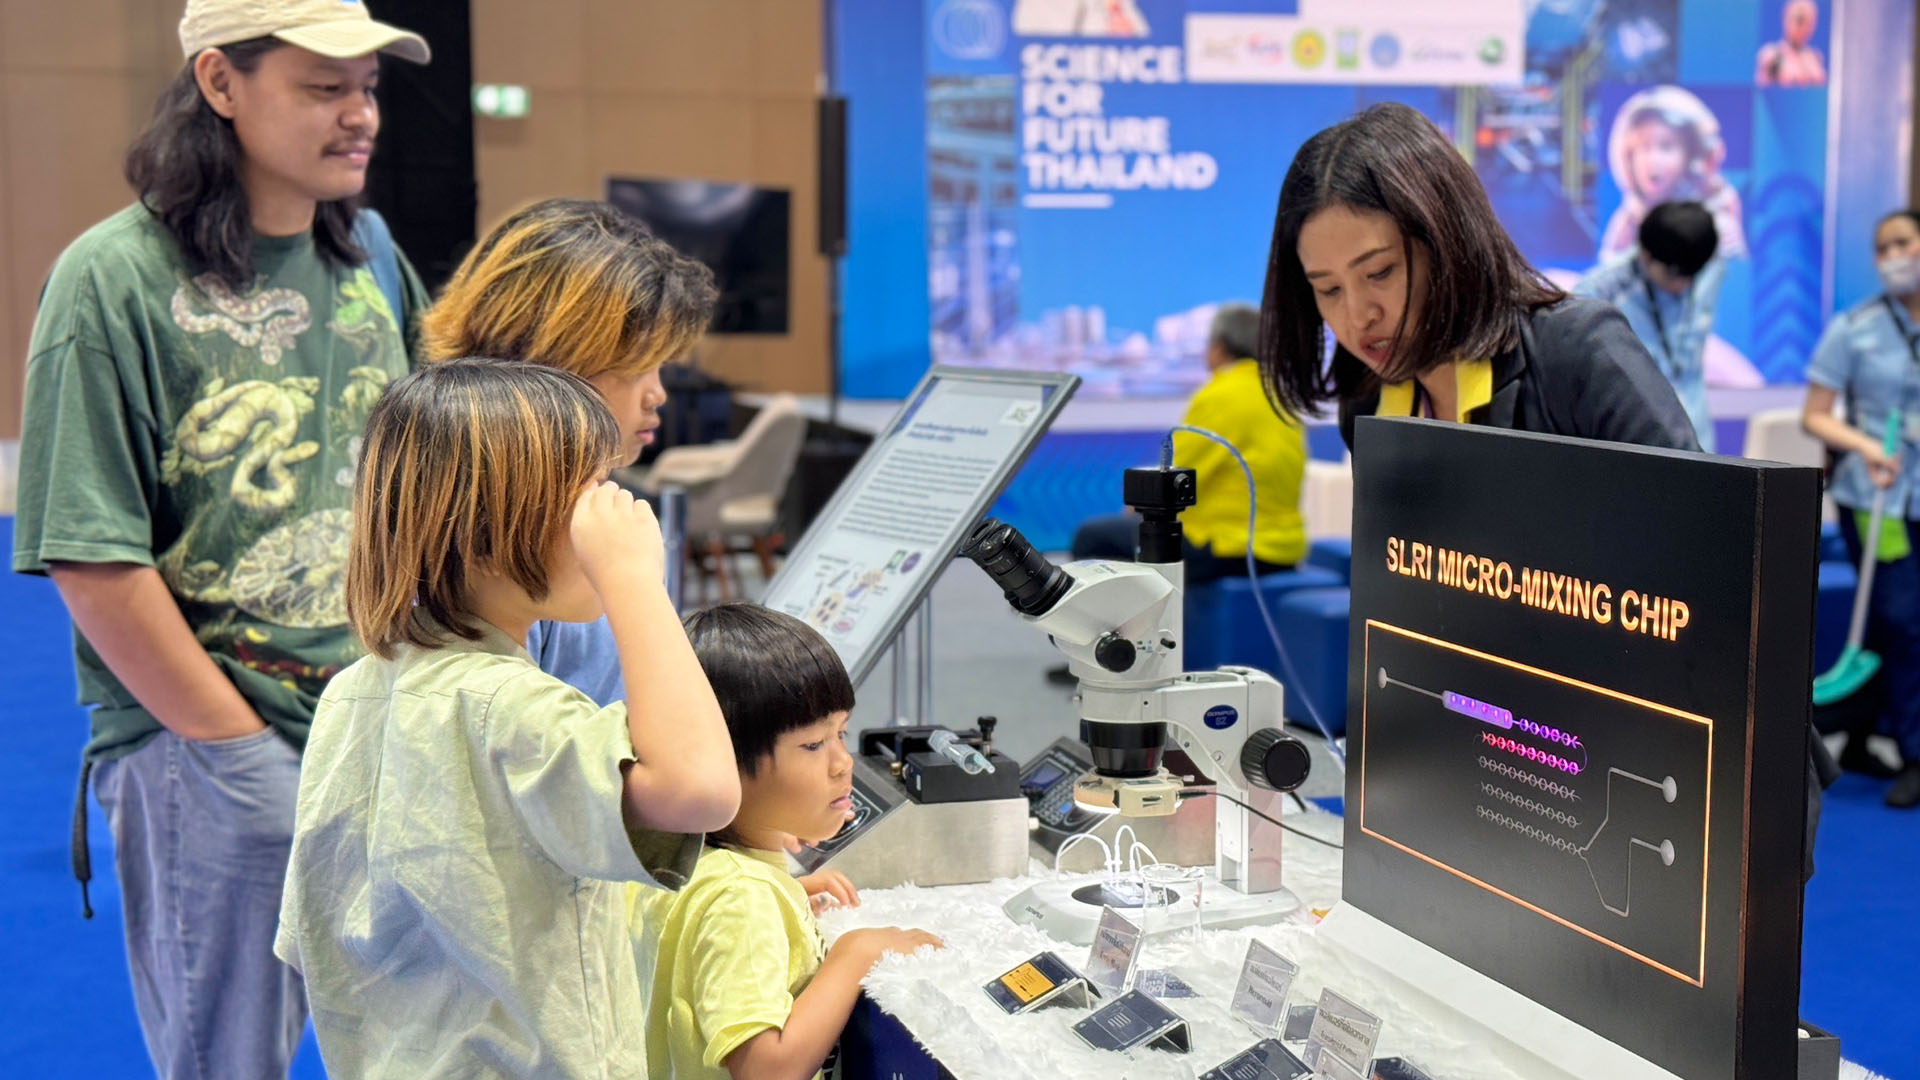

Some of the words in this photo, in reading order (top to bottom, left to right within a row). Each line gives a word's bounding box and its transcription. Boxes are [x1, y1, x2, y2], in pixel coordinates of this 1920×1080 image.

[1021, 44, 1182, 83] SCIENCE
[1023, 82, 1104, 117] FOR
[1023, 117, 1169, 153] FUTURE
[1022, 153, 1218, 189] THAILAND
[1386, 536, 1432, 580] SLRI
[1437, 547, 1612, 624] MICRO-MIXING
[1620, 589, 1690, 641] CHIP
